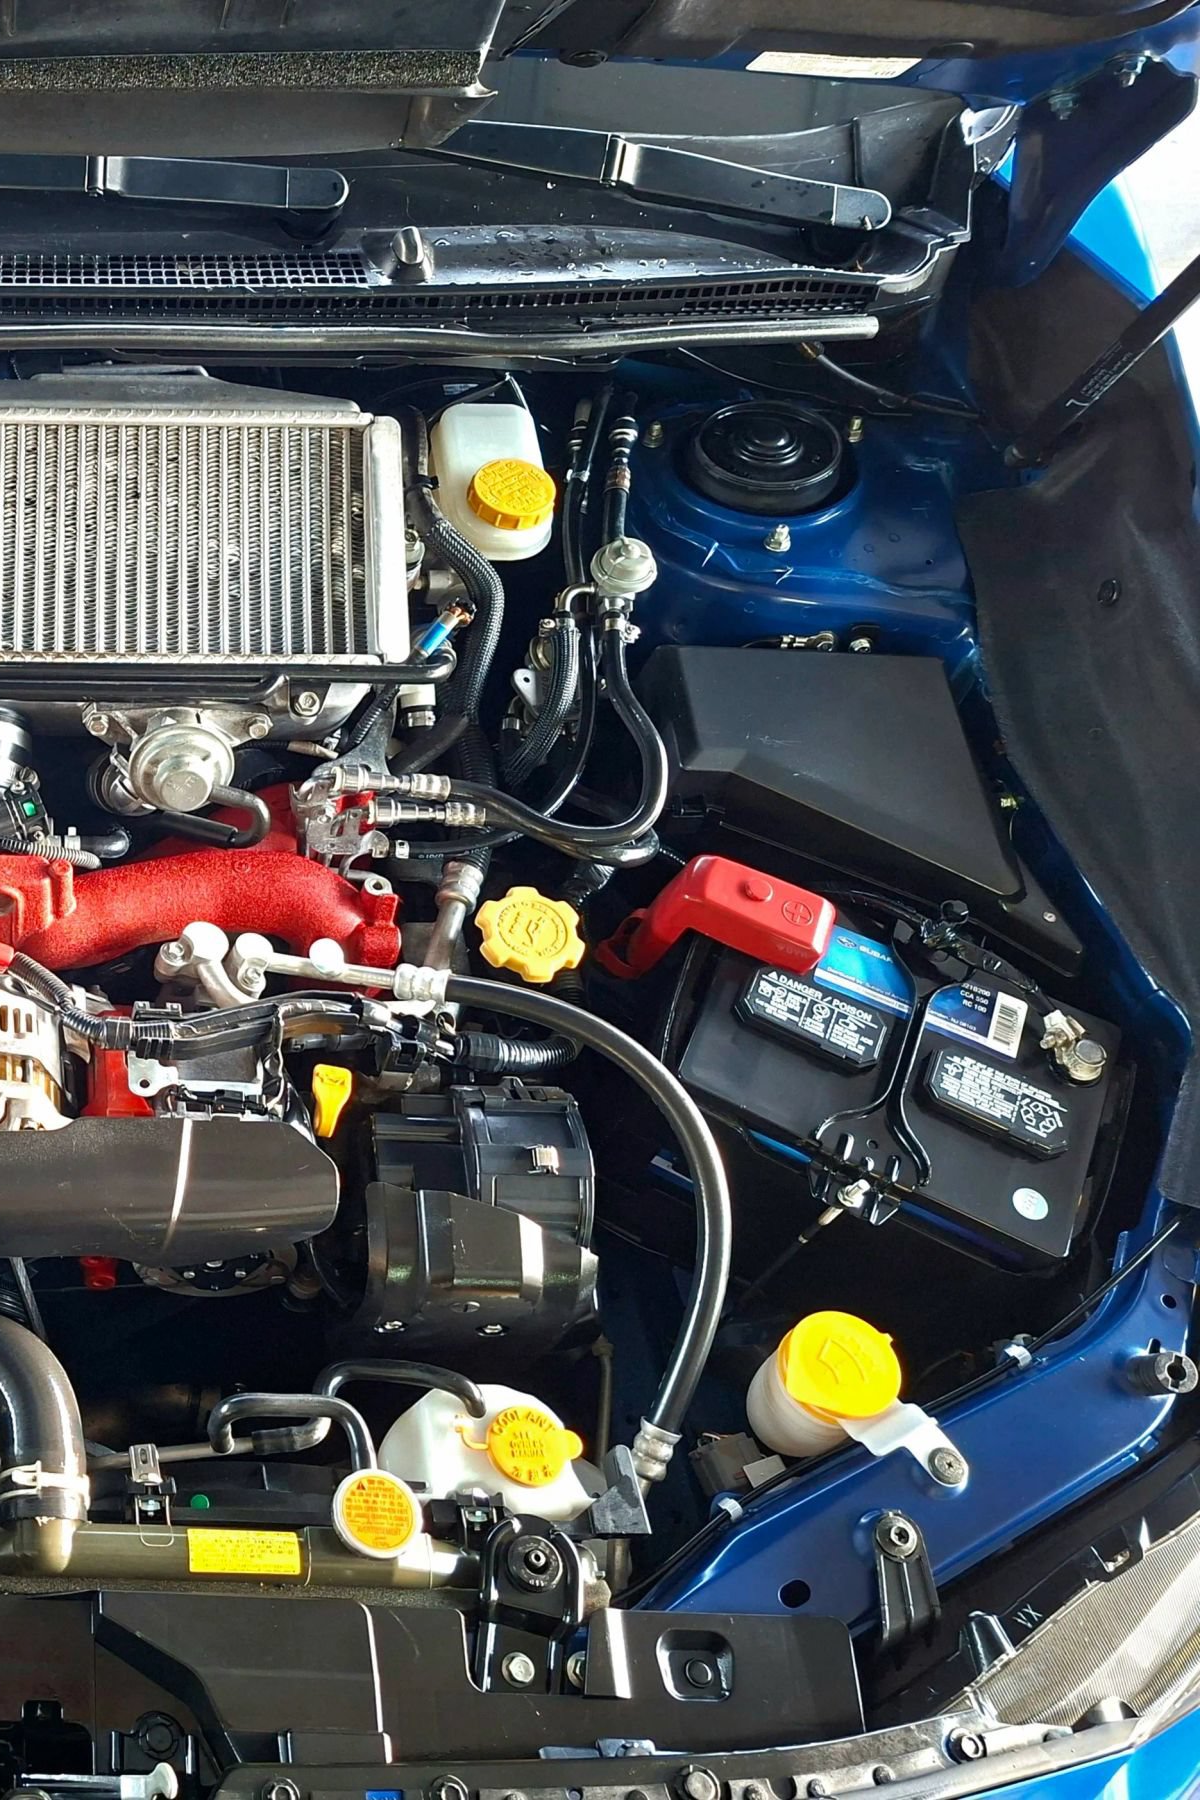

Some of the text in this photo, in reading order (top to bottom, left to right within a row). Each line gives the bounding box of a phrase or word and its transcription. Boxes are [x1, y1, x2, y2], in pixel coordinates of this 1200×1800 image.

[859, 945, 893, 963] SUBAR
[780, 975, 822, 1000] DANGER
[832, 998, 872, 1022] POISON
[960, 990, 974, 1000] CCA
[962, 999, 987, 1014] RC 100
[1012, 1603, 1043, 1628] VX
